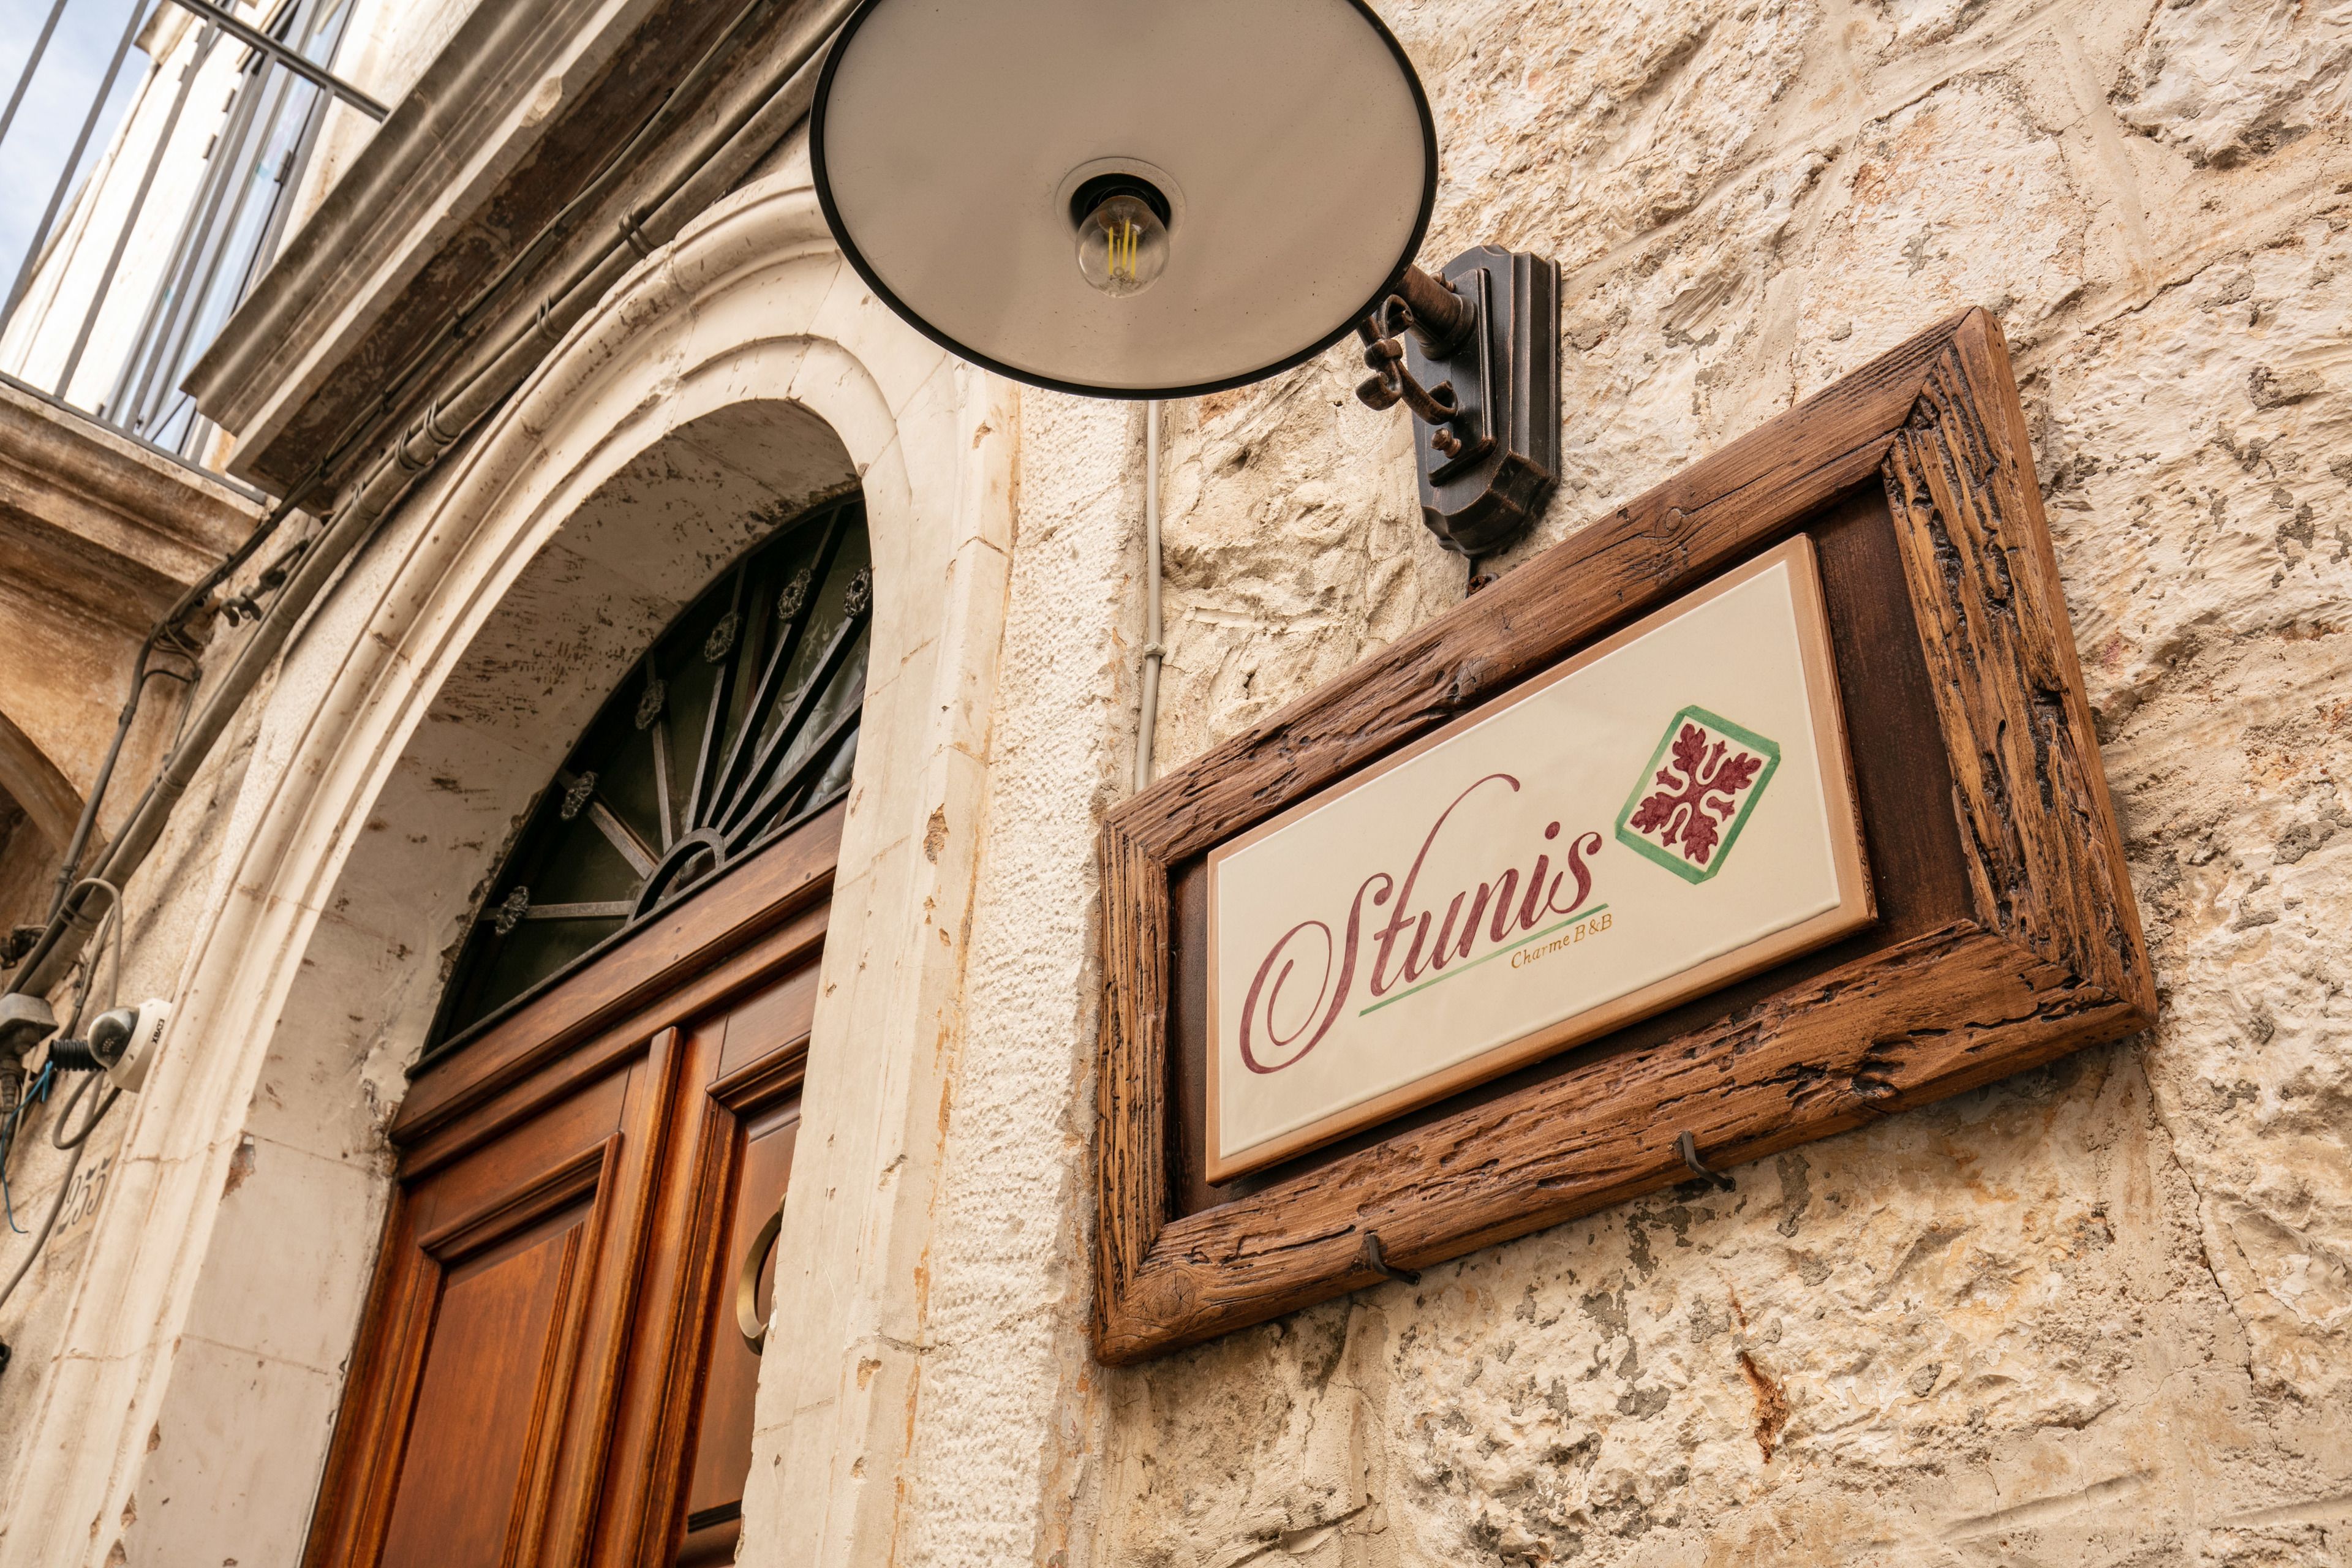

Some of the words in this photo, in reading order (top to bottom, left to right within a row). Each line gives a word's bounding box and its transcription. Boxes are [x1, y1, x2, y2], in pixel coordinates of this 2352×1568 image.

[1240, 774, 1602, 1074] Stunis
[1510, 935, 1570, 969] Charme
[54, 1155, 111, 1237] 255
